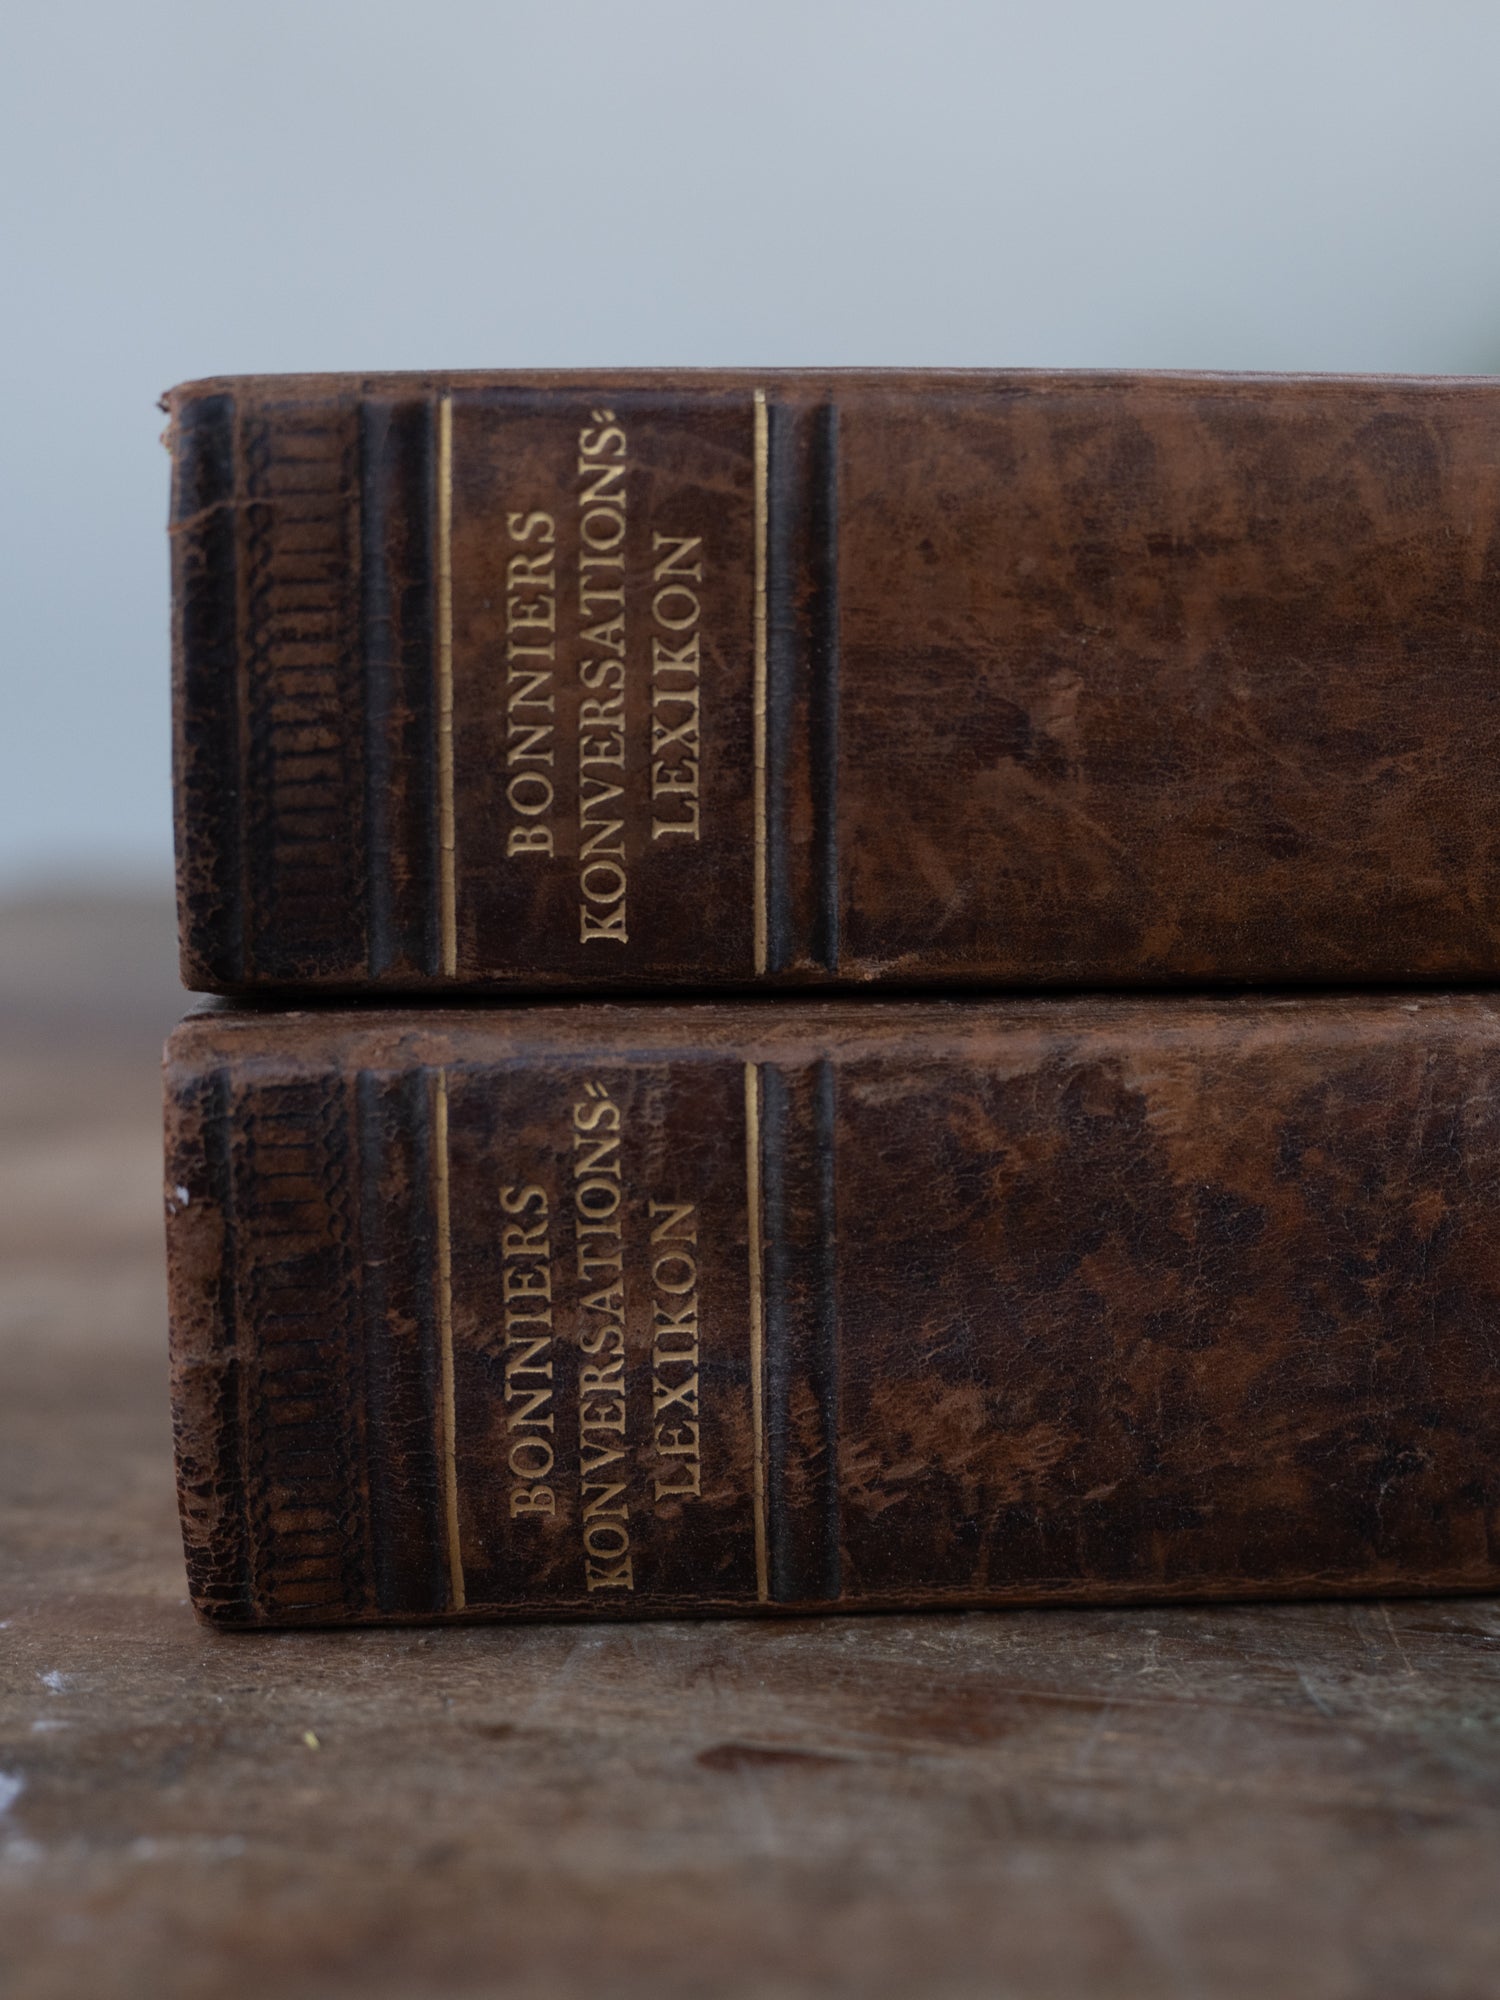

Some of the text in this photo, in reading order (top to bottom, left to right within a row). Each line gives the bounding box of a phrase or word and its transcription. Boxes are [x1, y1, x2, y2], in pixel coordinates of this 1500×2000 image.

[506, 511, 555, 857] BONNIERS
[652, 531, 702, 840] LEXIKON
[500, 1184, 555, 1518] BONNIERS
[649, 1198, 701, 1502] LEXIKON
